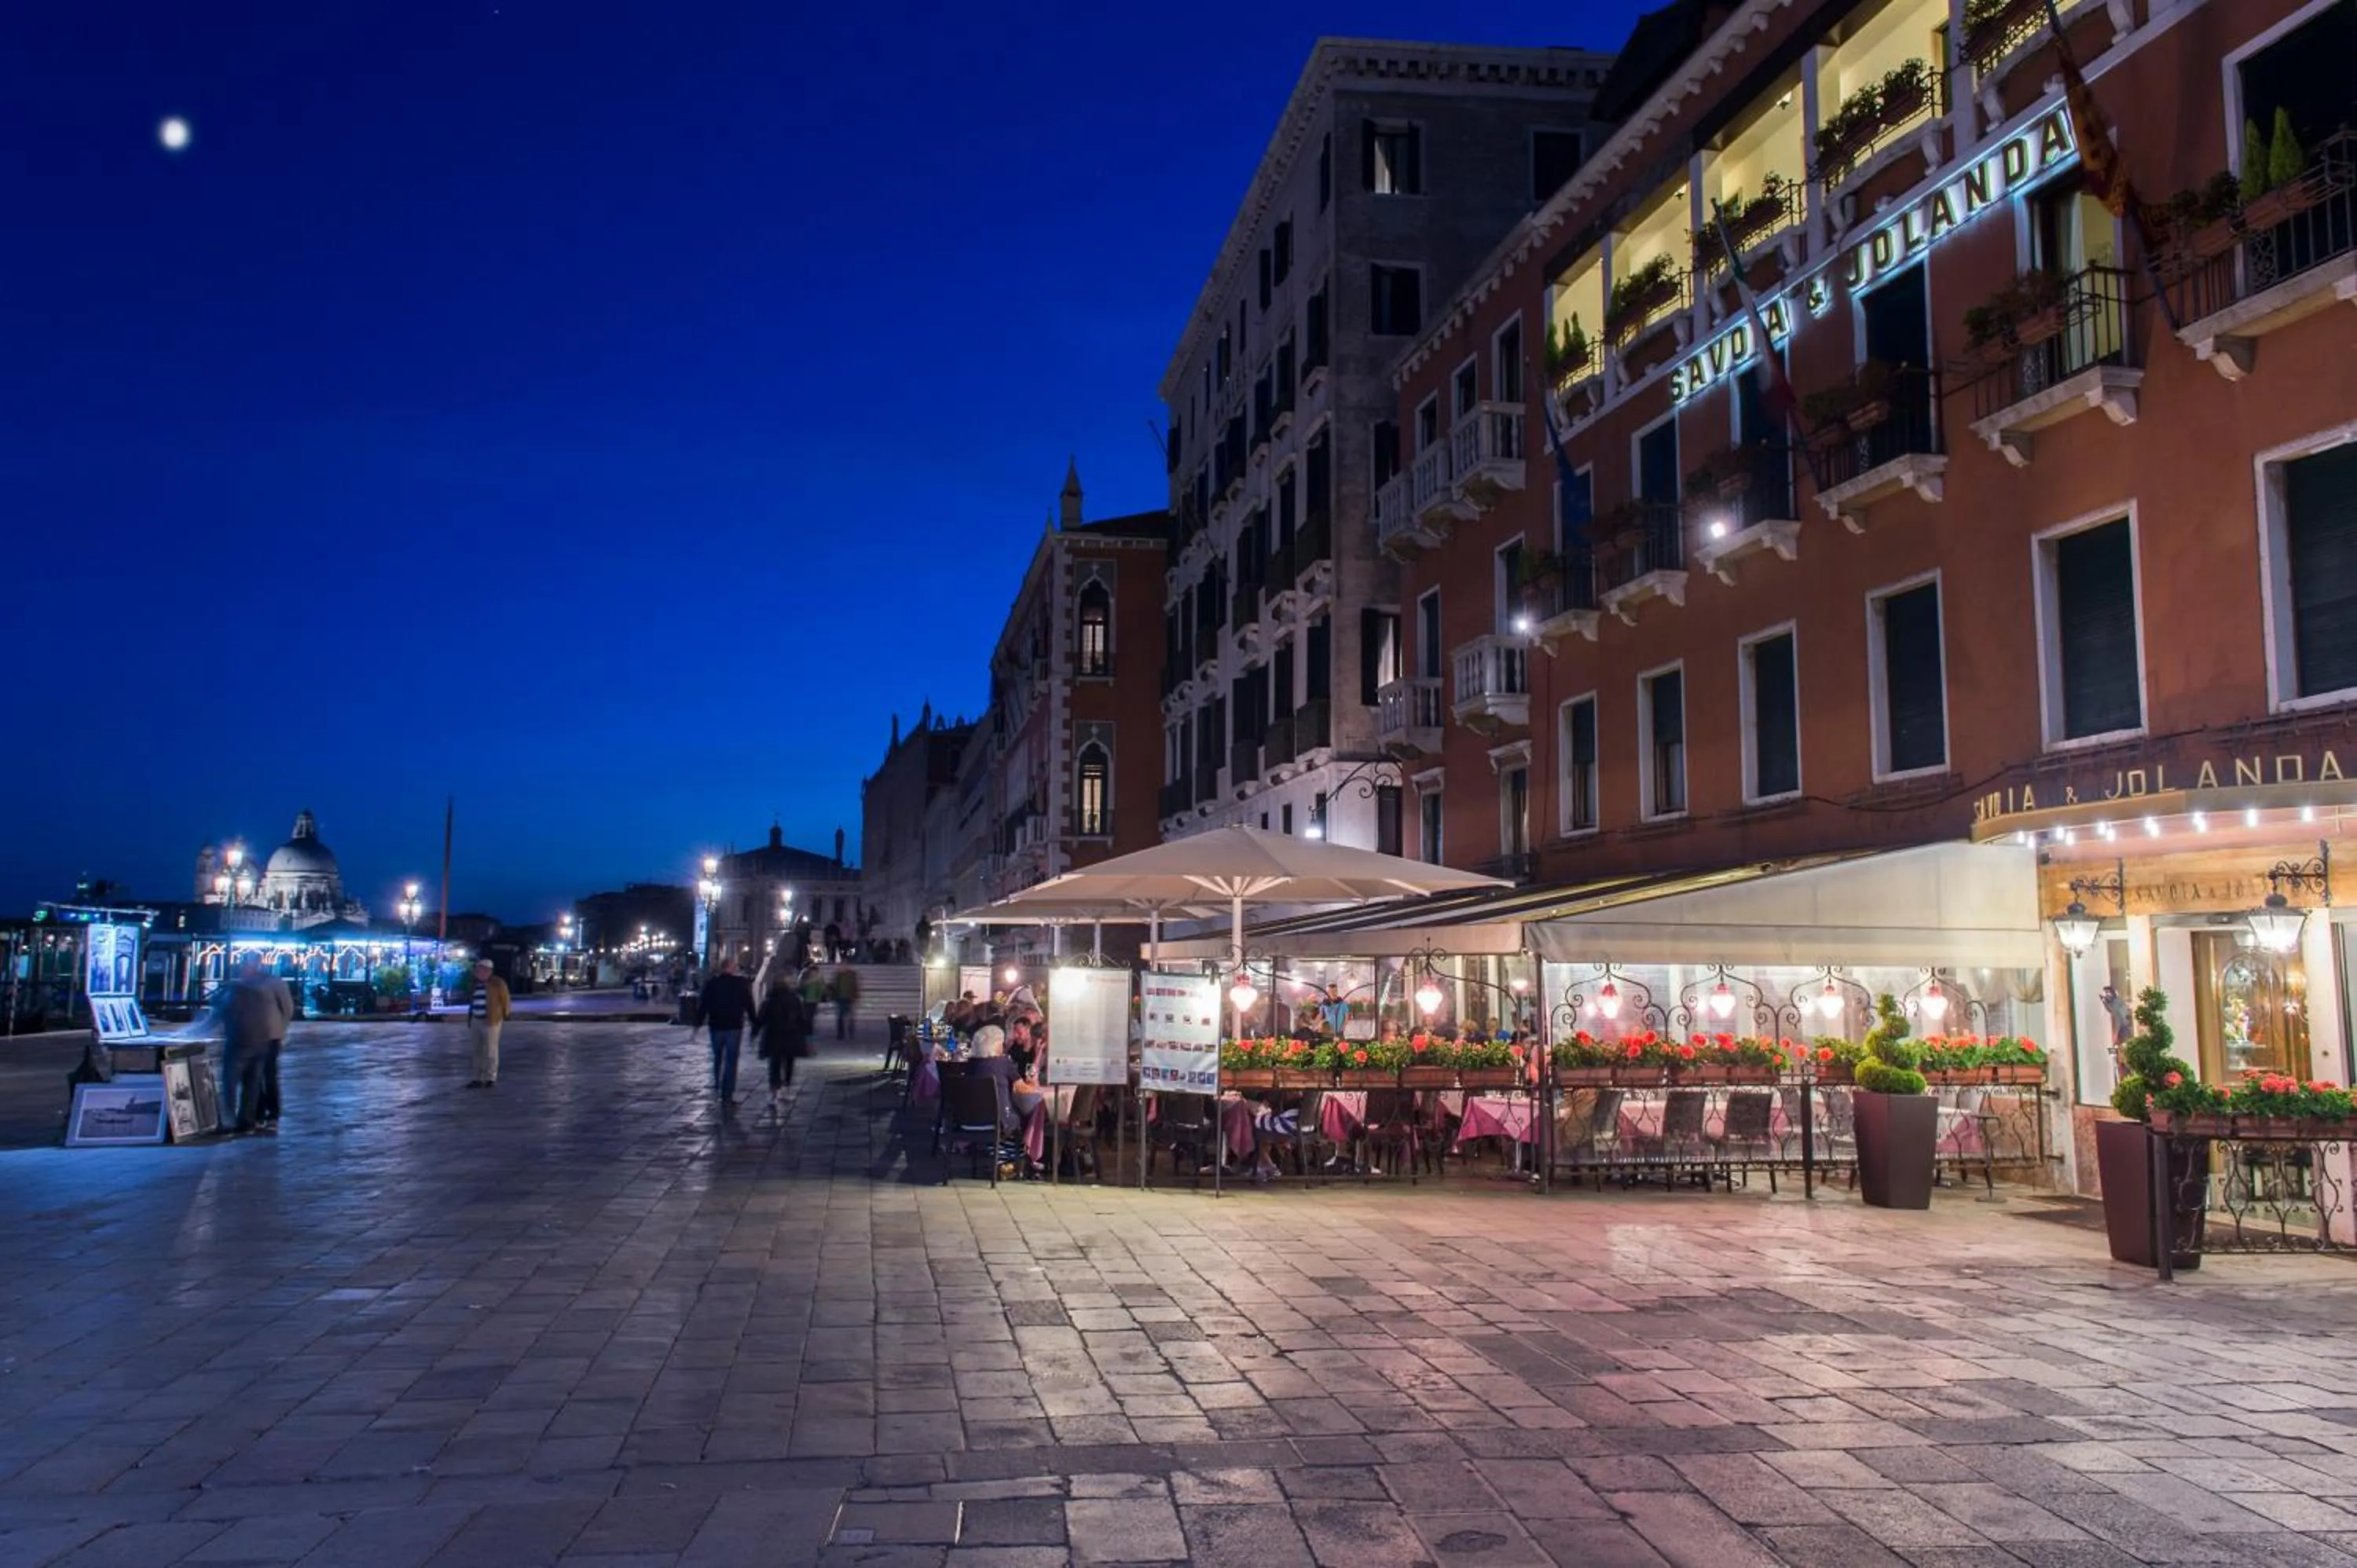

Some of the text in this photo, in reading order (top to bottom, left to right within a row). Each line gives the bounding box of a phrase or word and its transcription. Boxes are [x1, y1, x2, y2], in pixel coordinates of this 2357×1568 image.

[1671, 108, 2075, 404] SAVOA & JOLANDA
[2066, 786, 2078, 804] &
[2105, 750, 2344, 800] JOLANDA
